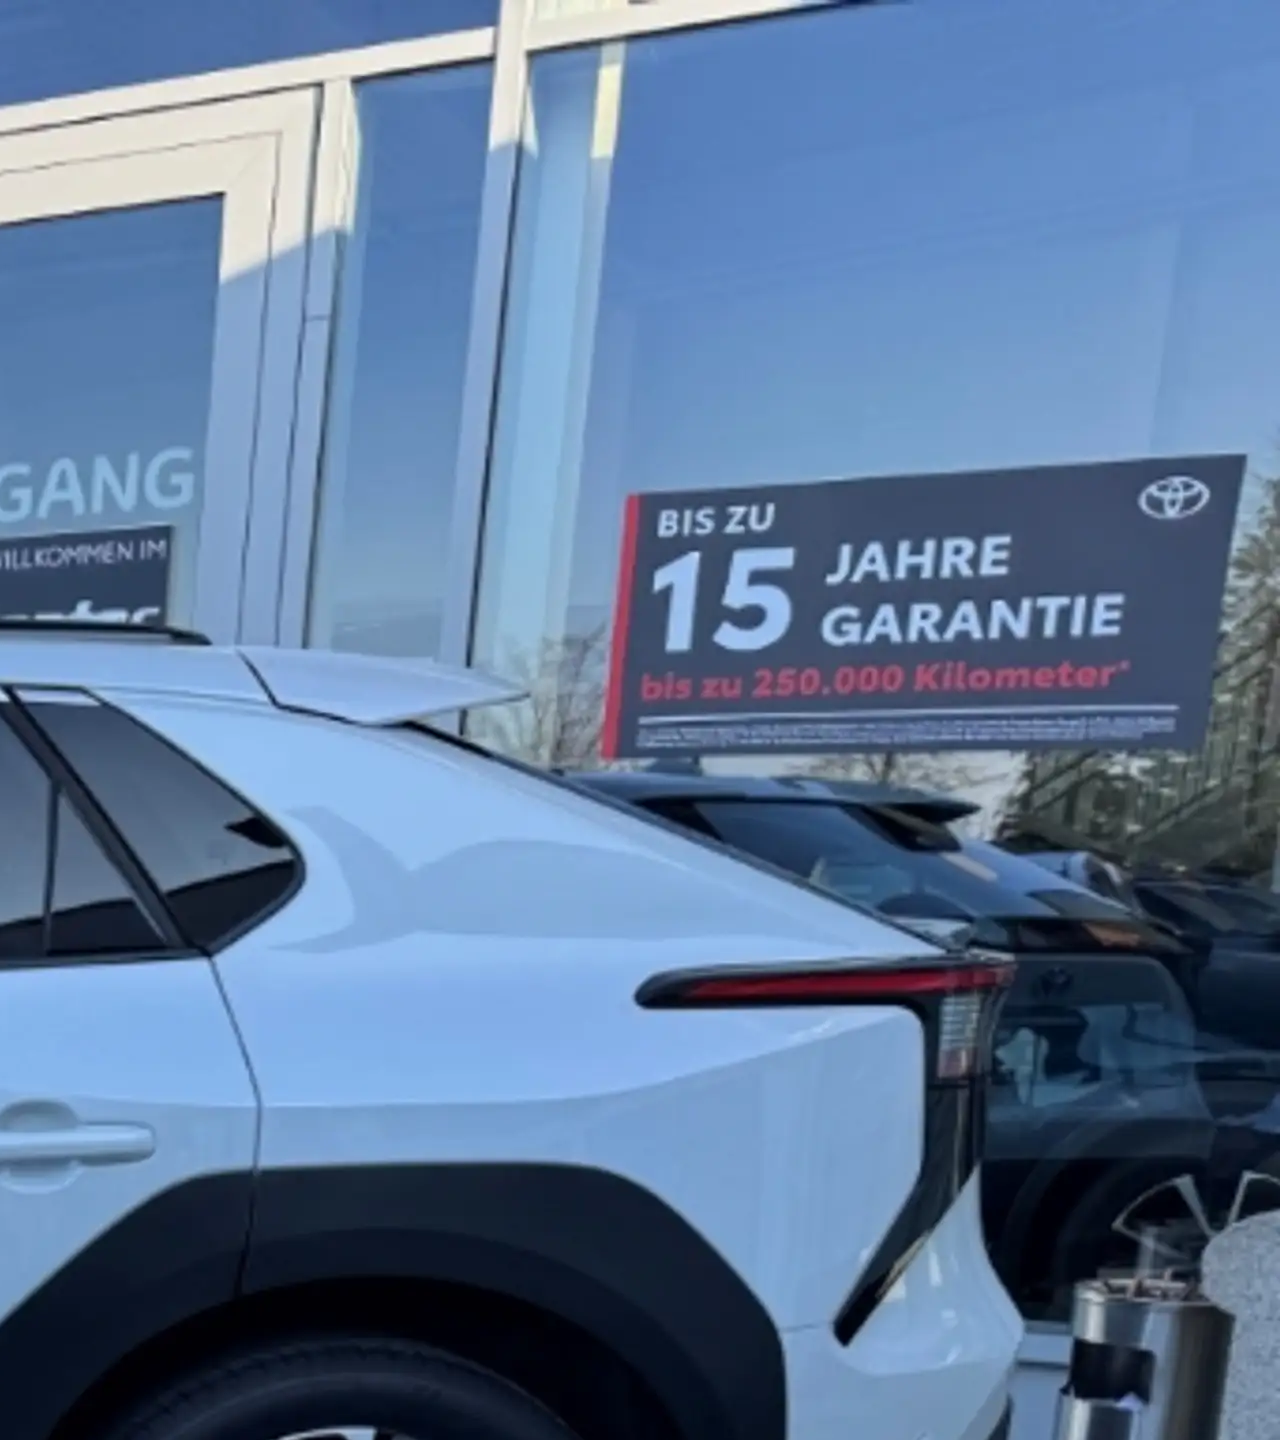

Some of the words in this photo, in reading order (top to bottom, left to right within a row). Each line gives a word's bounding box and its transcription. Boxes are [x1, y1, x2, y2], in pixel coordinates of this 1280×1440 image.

[657, 508, 715, 538] BIS
[724, 503, 775, 534] ZU
[140, 539, 167, 559] IM
[826, 535, 1012, 585] JAHRE
[652, 546, 797, 652] 15
[821, 594, 1126, 647] GARANTIE
[641, 672, 692, 700] bis
[701, 675, 743, 698] zu
[752, 664, 905, 697] 250.000
